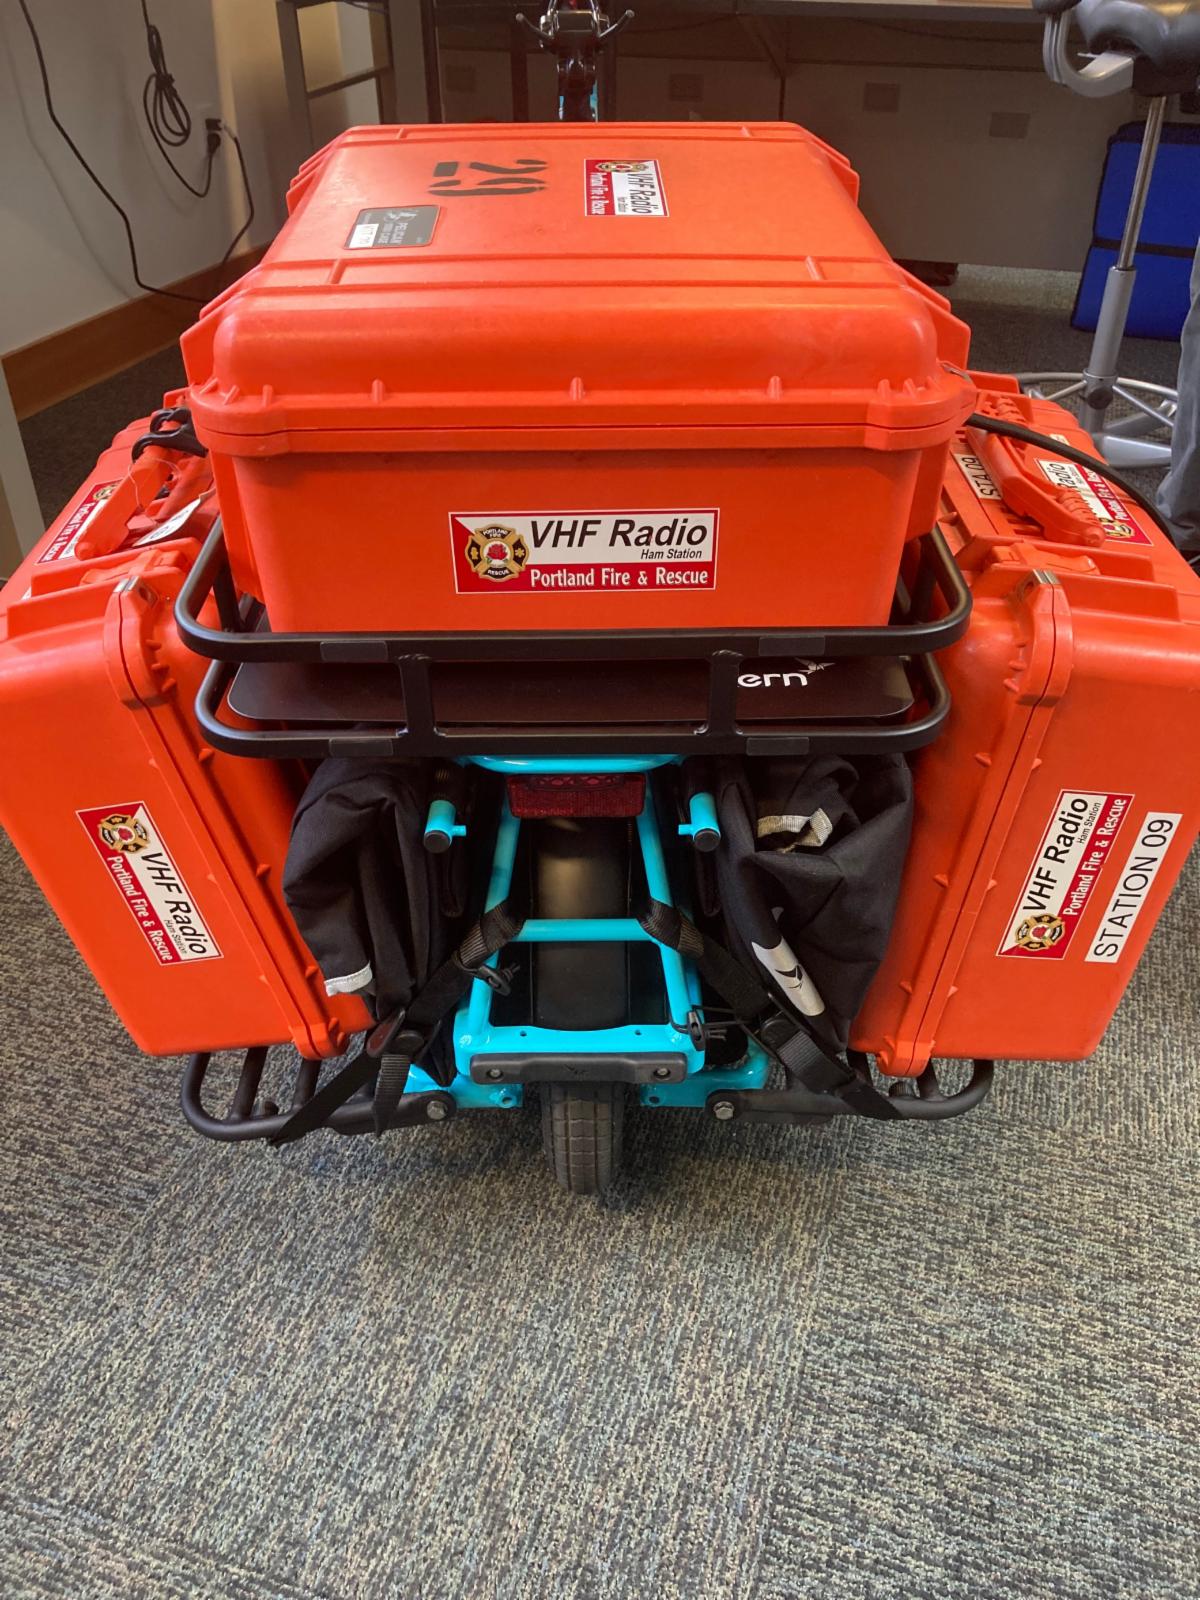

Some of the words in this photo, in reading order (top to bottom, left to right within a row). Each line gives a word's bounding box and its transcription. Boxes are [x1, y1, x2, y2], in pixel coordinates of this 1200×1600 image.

[427, 158, 549, 197] 29
[627, 173, 655, 189] VHF
[628, 189, 659, 214] Radio
[389, 222, 408, 243] PELICAN
[1047, 463, 1078, 488] adio
[482, 528, 509, 536] PORTLAND
[530, 519, 602, 548] VHF
[608, 518, 708, 547] Radio
[640, 549, 665, 560] Ham
[666, 548, 702, 559] Station
[530, 568, 595, 588] Portland
[601, 567, 630, 586] Fire
[637, 571, 648, 585] &
[655, 566, 709, 585] Rescue
[736, 672, 808, 688] ern
[1083, 801, 1102, 827] Station
[1096, 797, 1127, 836] Rescue
[1077, 825, 1091, 844] Ham
[1094, 839, 1110, 848] &
[1022, 866, 1058, 910] VHF
[1043, 797, 1089, 864] Radio
[1081, 851, 1105, 872] Fire
[106, 855, 142, 897] Portland
[1093, 855, 1158, 957] STATION
[1140, 818, 1174, 848] 09
[141, 852, 183, 895] VHF
[164, 899, 209, 954] Radio
[1062, 873, 1094, 916] Portland
[130, 897, 150, 918] Fire
[142, 920, 156, 928] &
[148, 929, 174, 962] Rescue
